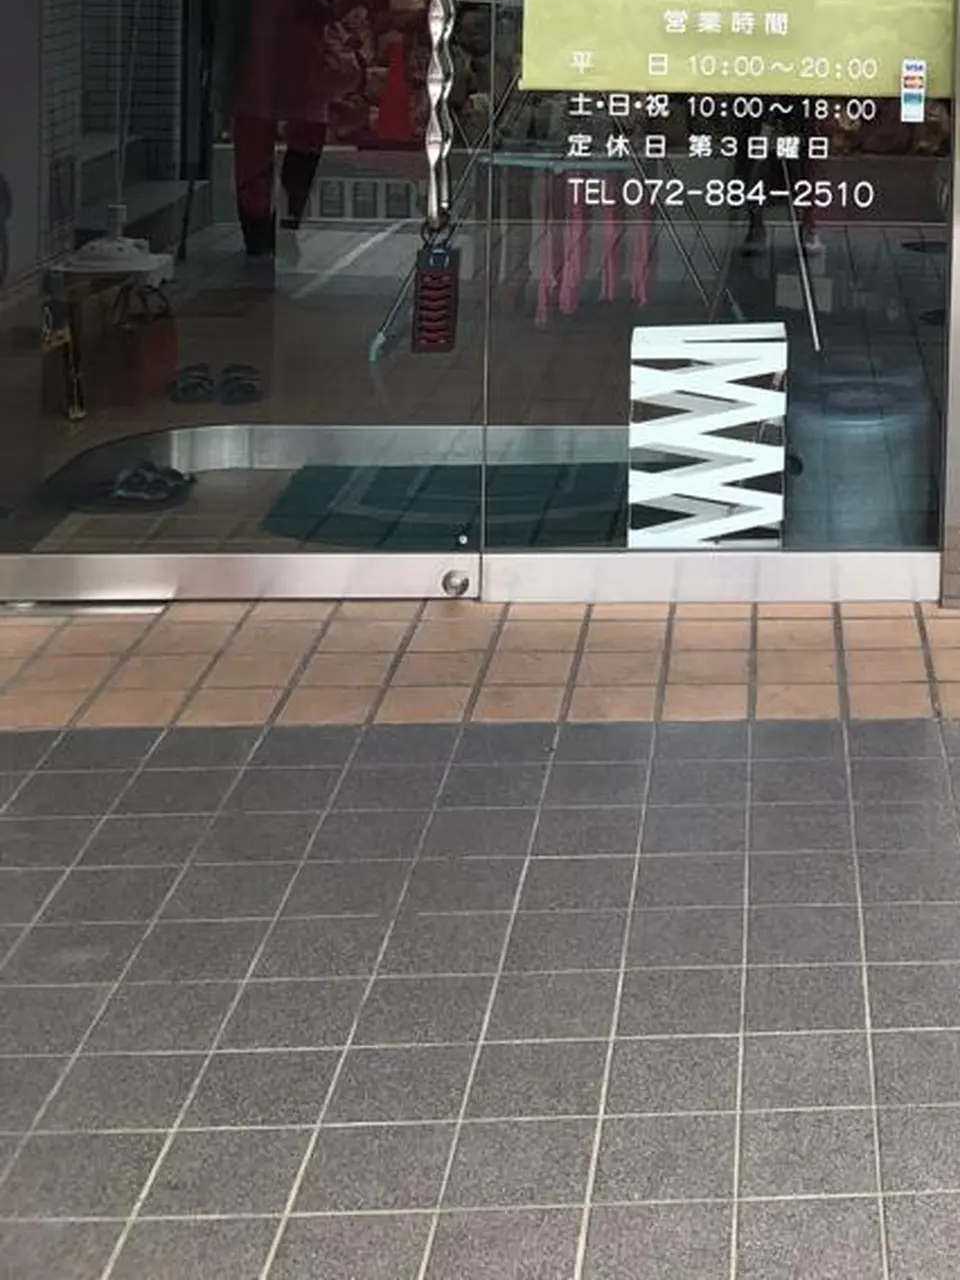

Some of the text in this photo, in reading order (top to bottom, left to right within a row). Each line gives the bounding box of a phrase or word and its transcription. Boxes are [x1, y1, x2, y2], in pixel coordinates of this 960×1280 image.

[663, 9, 790, 36] 営業時間
[567, 133, 830, 160] 定休日 第3日曜日
[567, 178, 875, 209] TEL 072-884-2510
